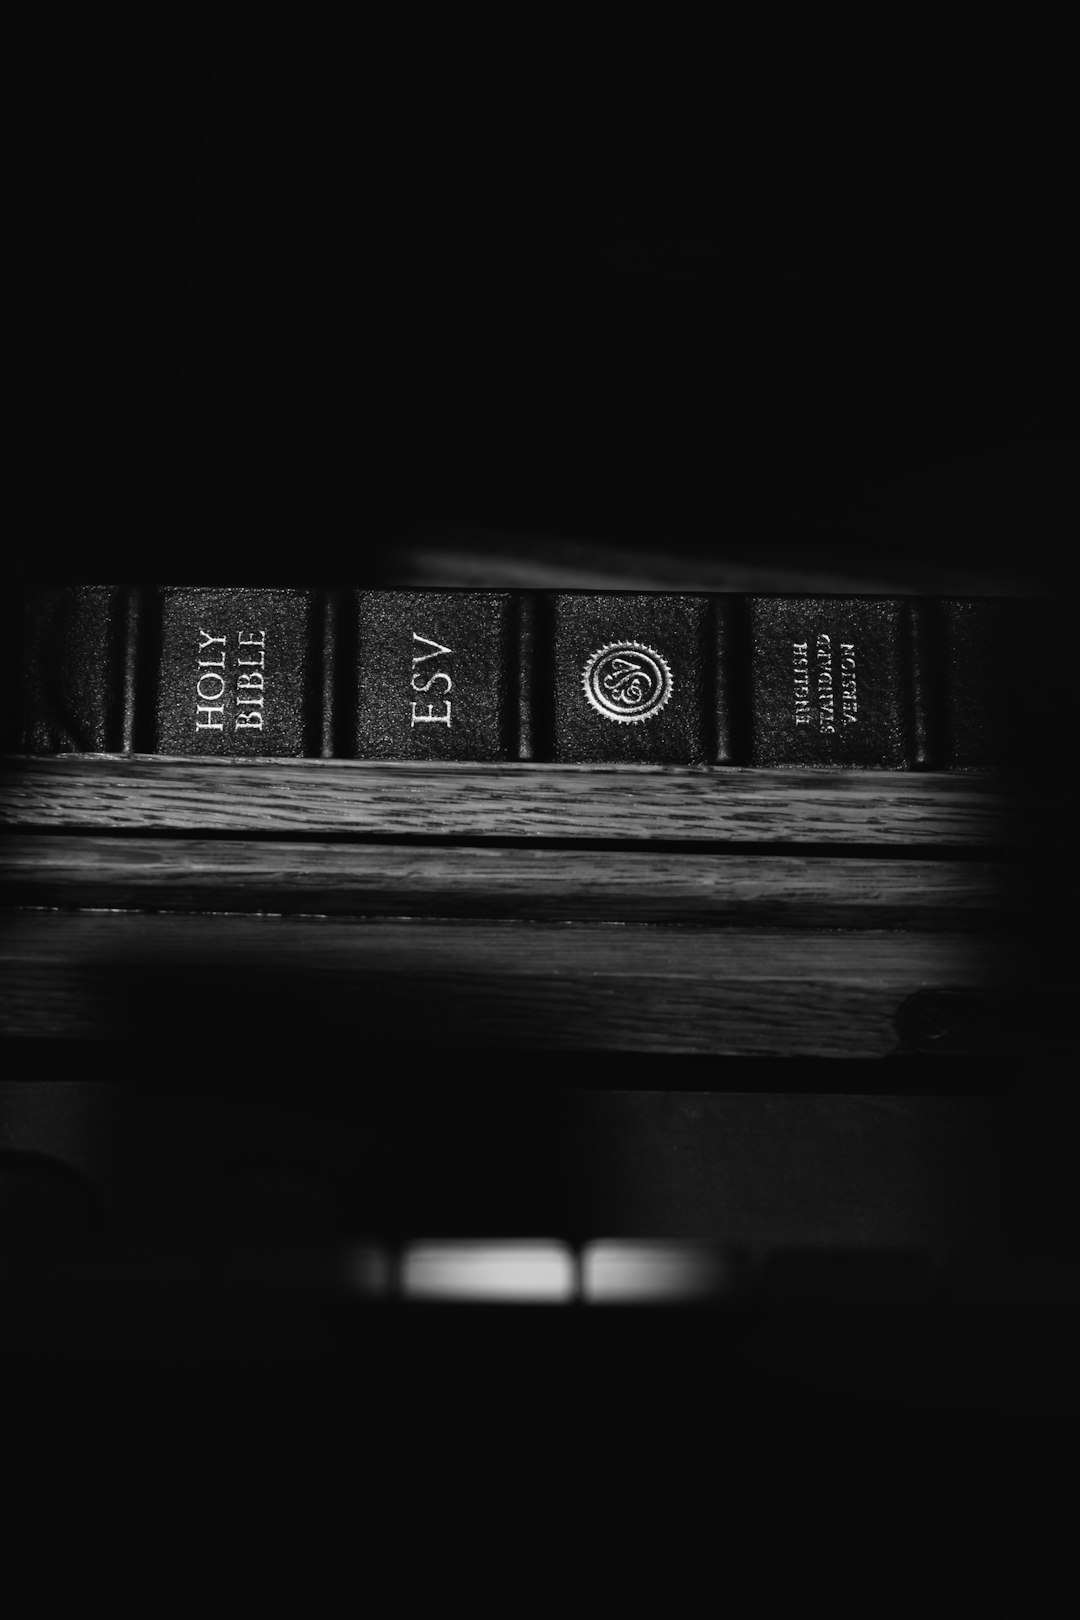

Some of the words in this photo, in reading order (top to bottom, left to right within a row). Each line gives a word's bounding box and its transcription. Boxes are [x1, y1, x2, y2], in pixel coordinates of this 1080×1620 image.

[195, 630, 226, 732] HOLY
[235, 630, 265, 732] BIBLE
[410, 632, 452, 728] ESV
[793, 642, 810, 726] ENGLISH
[816, 633, 835, 734] STANDARD
[840, 643, 858, 726] VERSION
